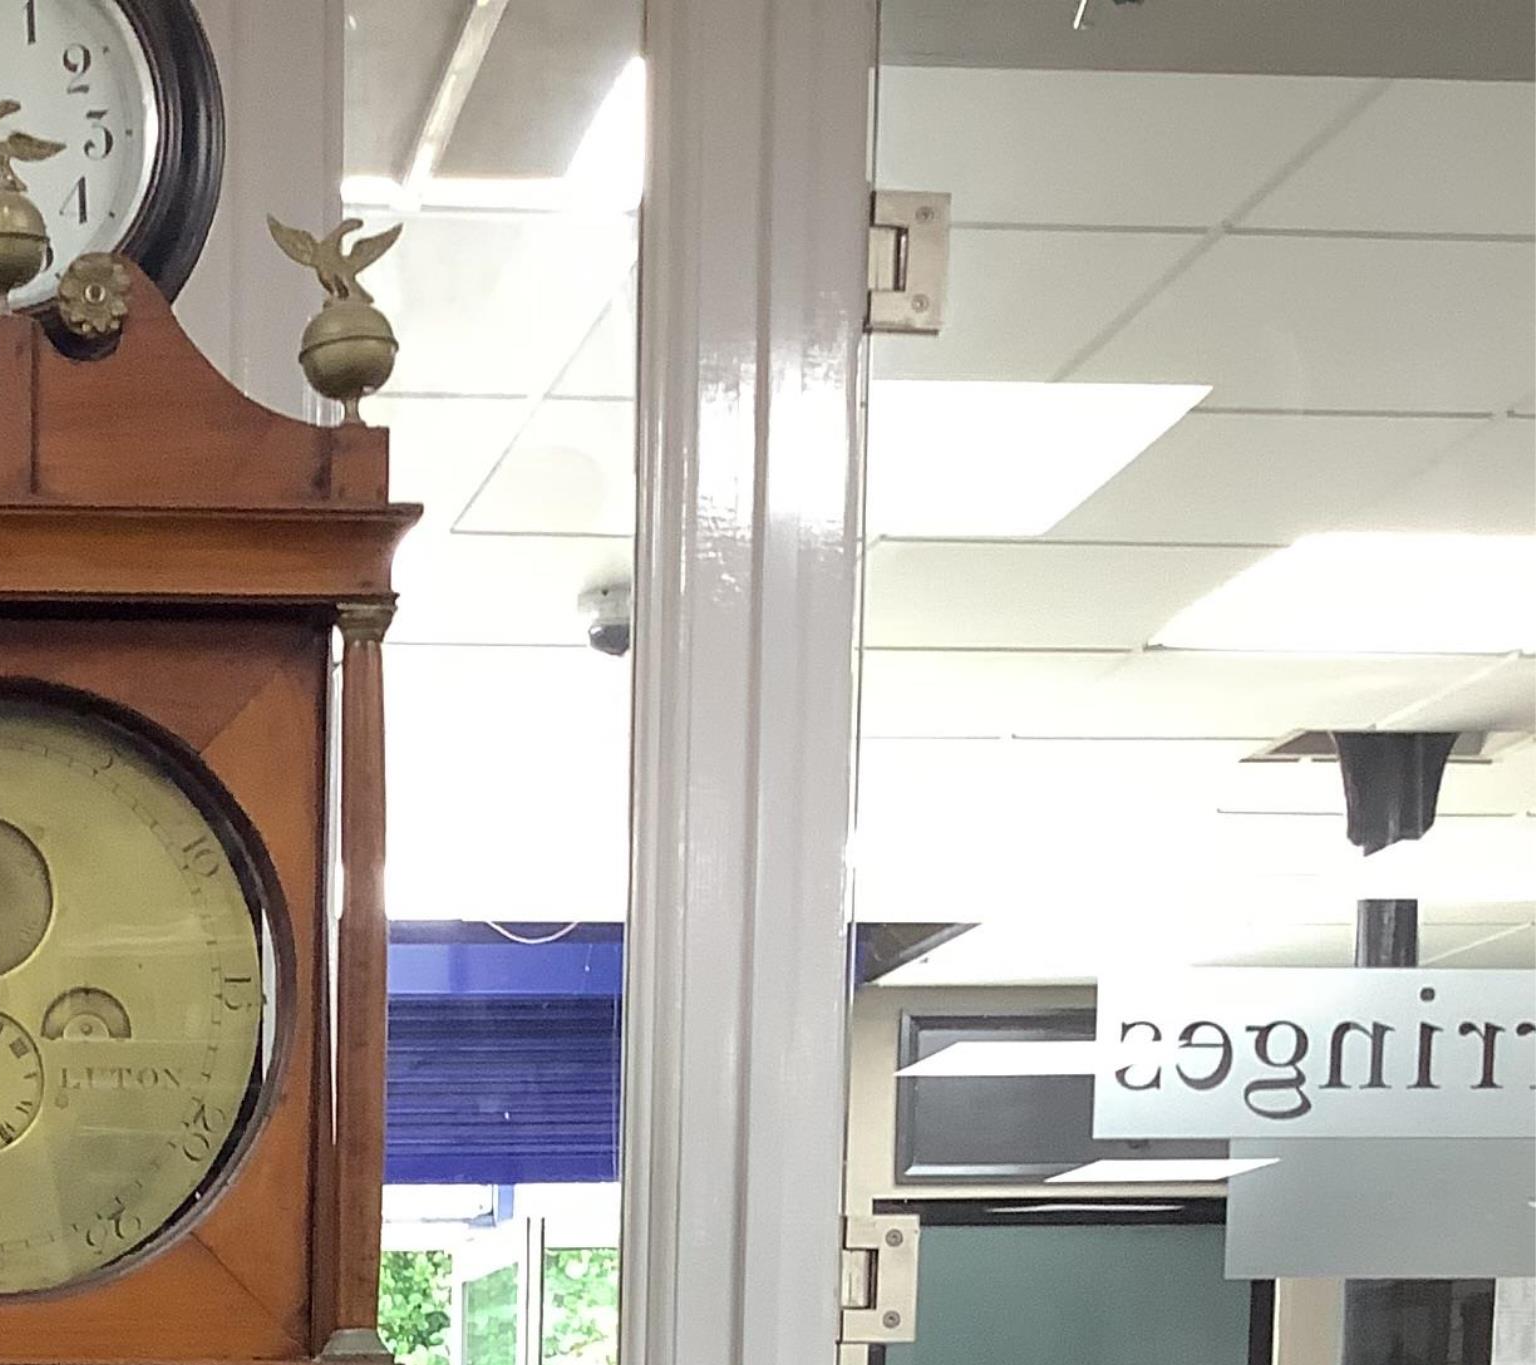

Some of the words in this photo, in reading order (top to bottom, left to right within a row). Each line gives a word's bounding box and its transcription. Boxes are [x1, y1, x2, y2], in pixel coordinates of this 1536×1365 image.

[62, 43, 92, 95] 2
[82, 108, 114, 161] 3
[59, 175, 88, 225] 4
